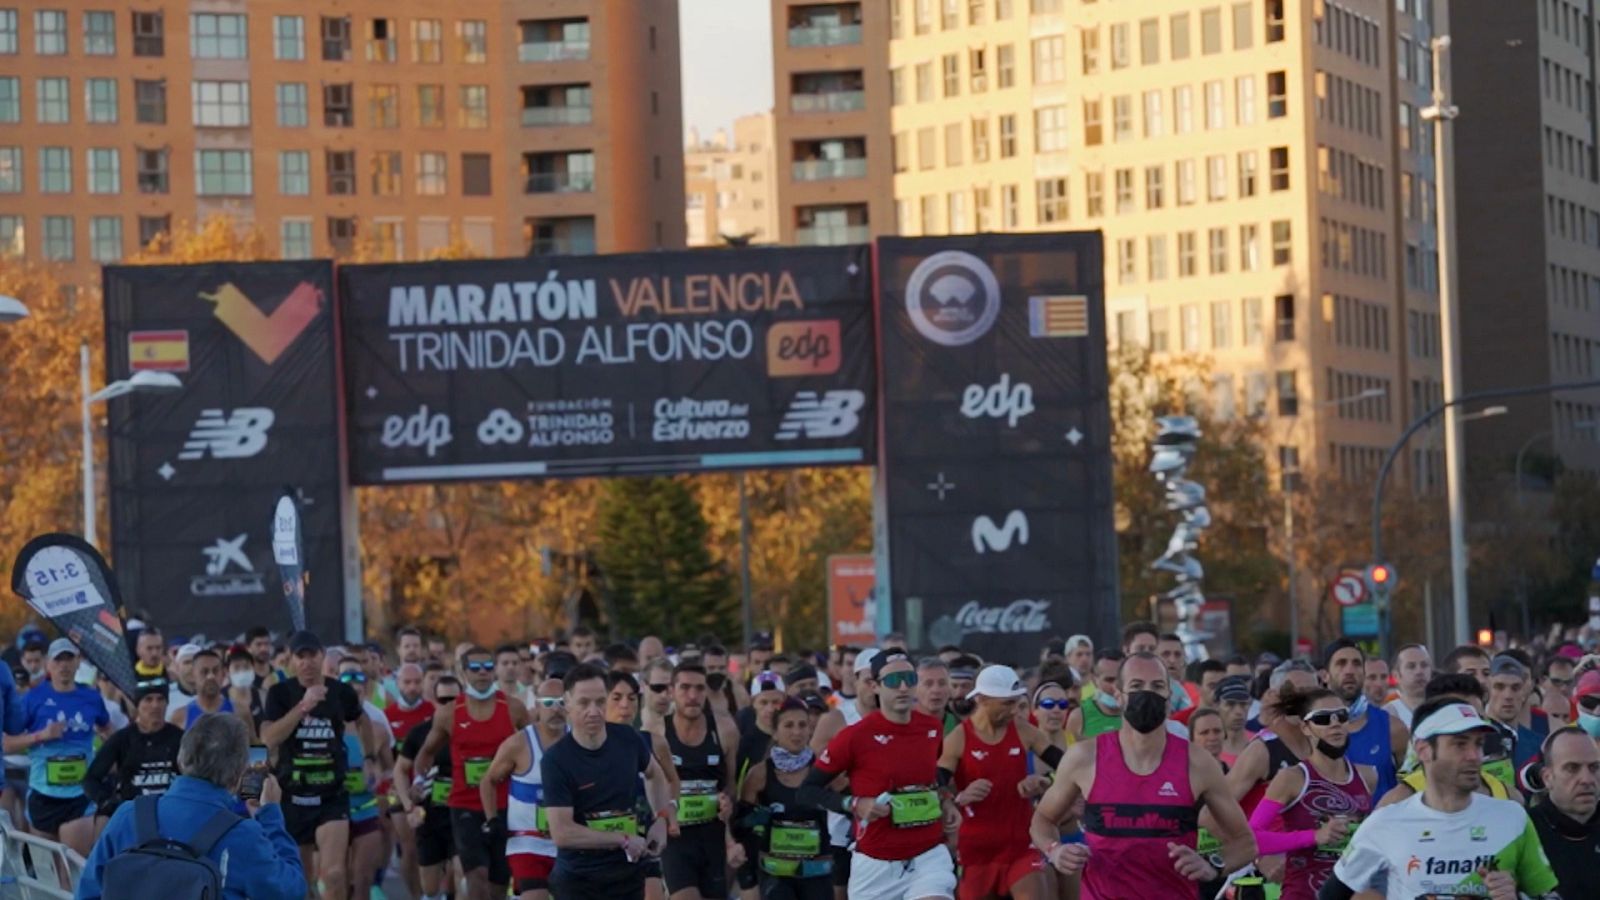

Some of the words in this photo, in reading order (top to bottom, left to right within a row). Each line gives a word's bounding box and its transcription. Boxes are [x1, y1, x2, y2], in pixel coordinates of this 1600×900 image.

[388, 271, 597, 326] MARATÓN
[609, 270, 804, 316] VALENCIA
[389, 328, 566, 372] TRINIDAD
[575, 318, 754, 365] ALFONSO
[776, 333, 832, 367] edp
[527, 398, 612, 411] FUNDACIÓN
[653, 396, 730, 419] Cultura
[960, 373, 1035, 428] edp
[381, 405, 452, 457] edp
[528, 411, 613, 431] TRINIDAD
[652, 418, 749, 443] Esfuerzo
[528, 428, 615, 448] ALFONSO
[1425, 855, 1502, 875] fanatik
